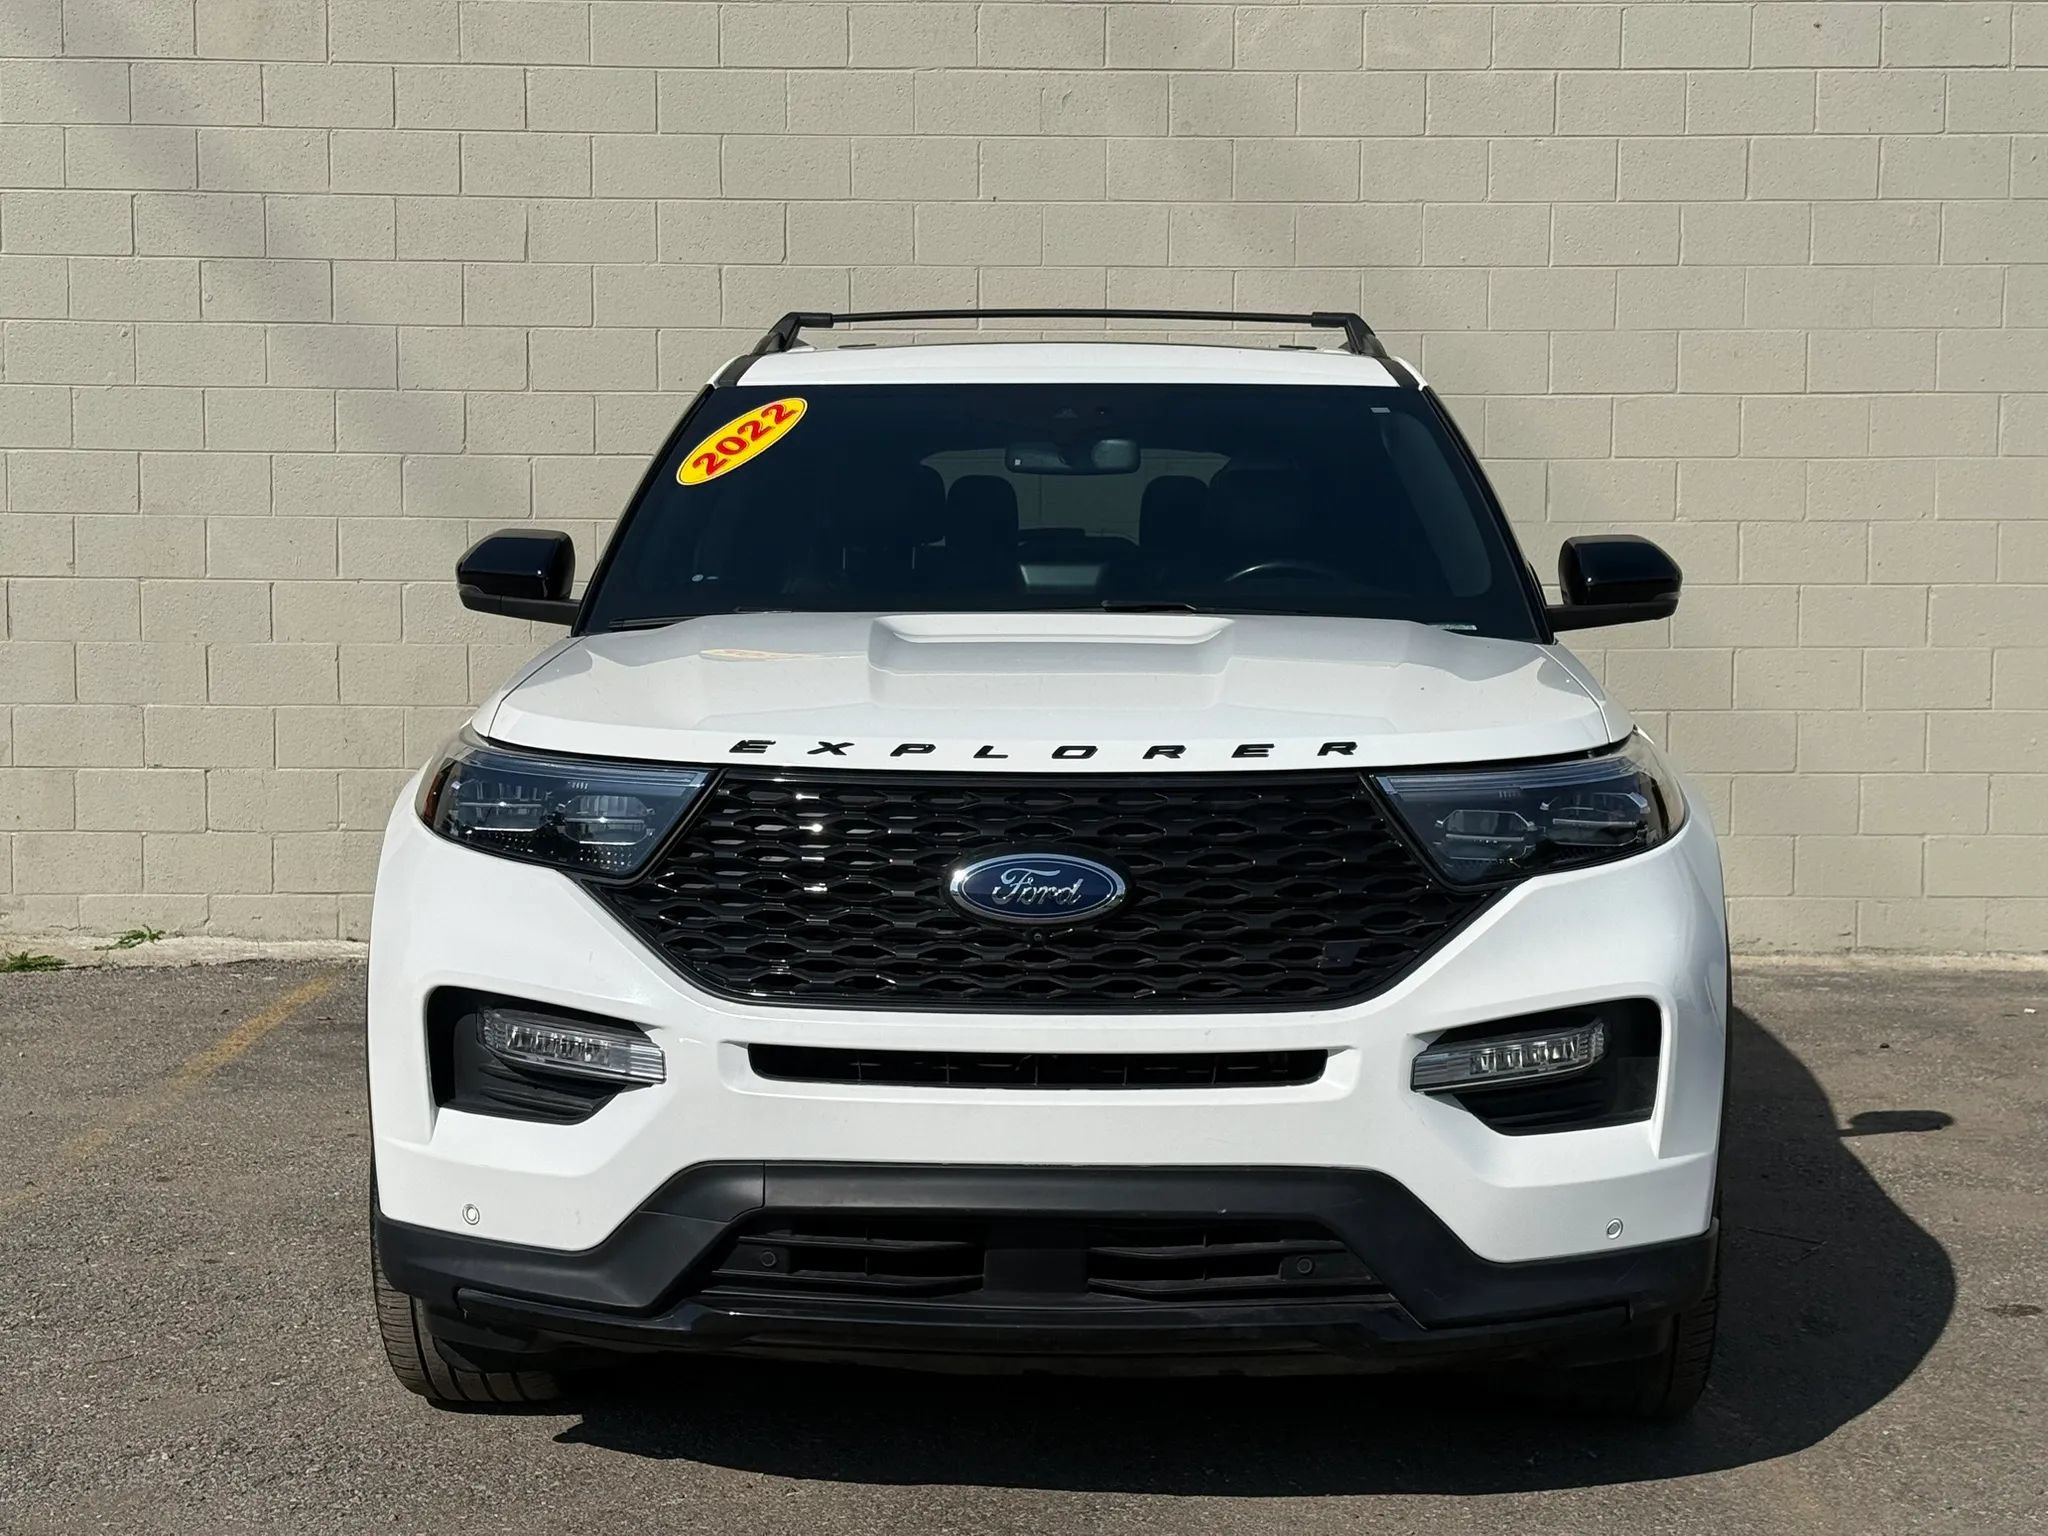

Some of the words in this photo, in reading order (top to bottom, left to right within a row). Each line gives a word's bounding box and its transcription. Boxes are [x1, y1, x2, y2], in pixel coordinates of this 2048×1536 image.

[692, 404, 798, 475] 2022
[729, 739, 1358, 759] EXPLORER
[992, 868, 1083, 904] Ford
